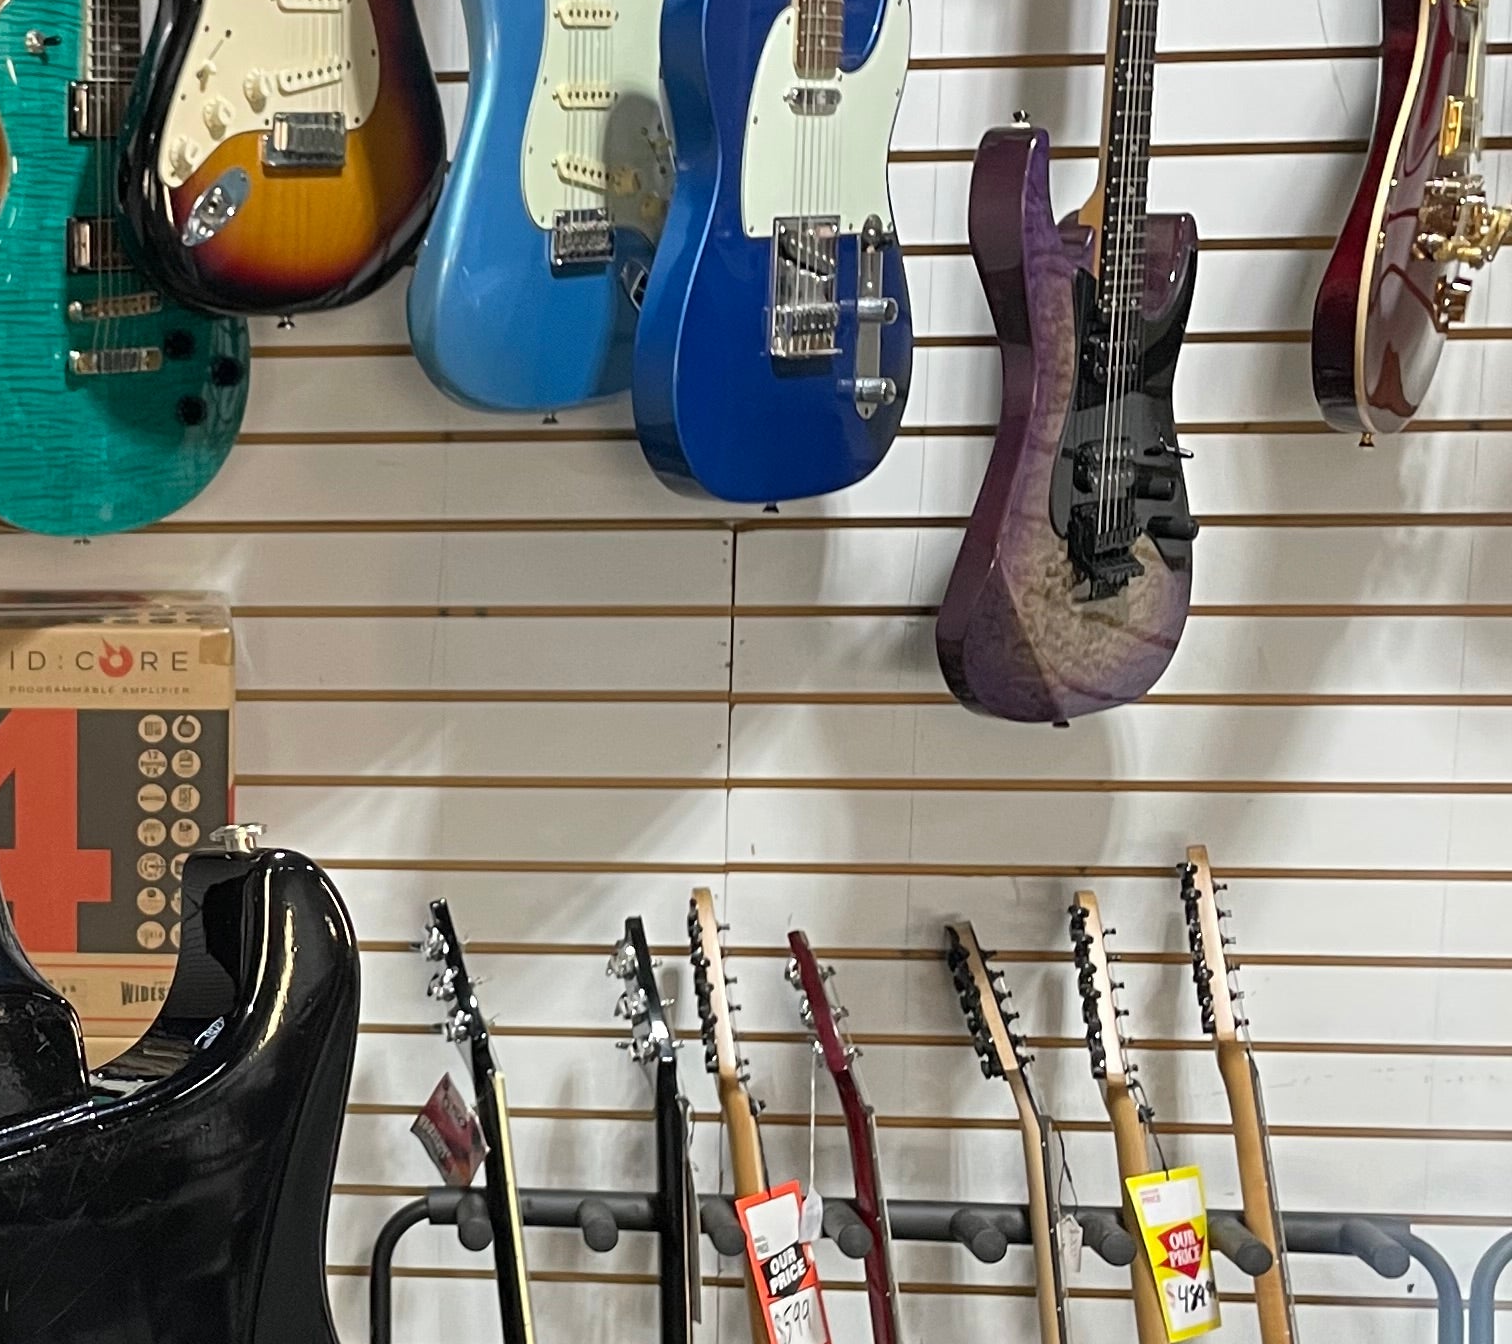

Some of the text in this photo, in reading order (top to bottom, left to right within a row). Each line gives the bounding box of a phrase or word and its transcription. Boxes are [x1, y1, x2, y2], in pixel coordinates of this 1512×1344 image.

[9, 686, 189, 694] PROGRAMMABLE AMPLIFIER
[1169, 1229, 1196, 1249] OUR
[770, 1247, 797, 1276] OUR
[1168, 1243, 1201, 1268] PRICE
[769, 1258, 807, 1296] PRICE
